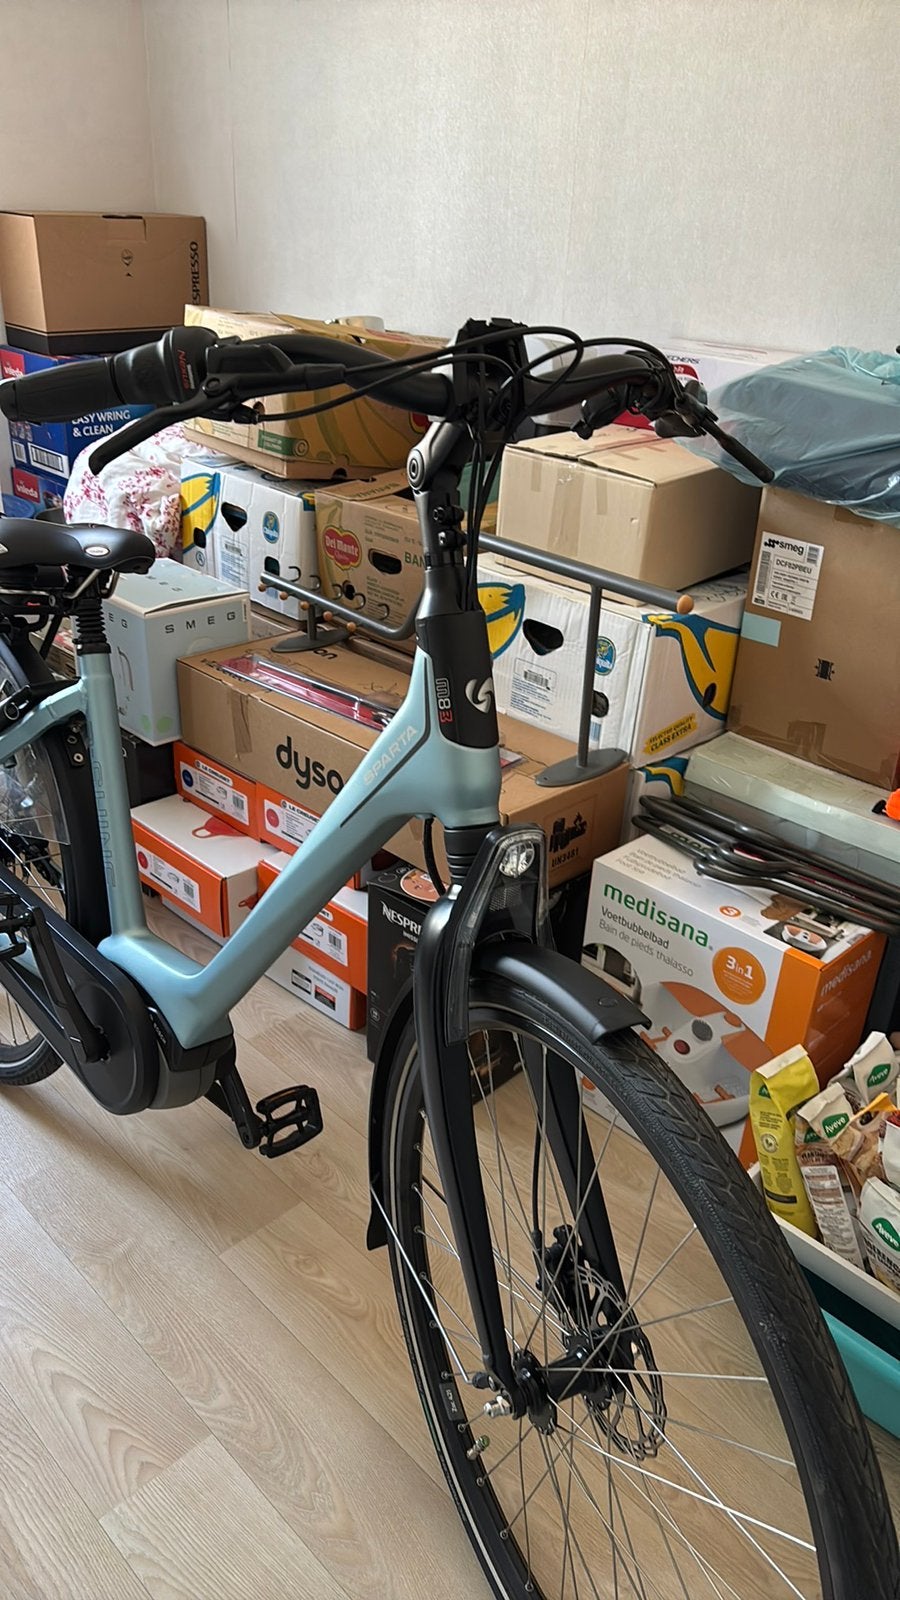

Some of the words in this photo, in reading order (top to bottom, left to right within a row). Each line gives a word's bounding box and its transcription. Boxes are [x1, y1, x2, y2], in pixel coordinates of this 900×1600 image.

[190, 241, 201, 306] ESPRESSO
[73, 426, 82, 438] &
[83, 424, 114, 435] CLEAN
[97, 409, 131, 420] WRING
[325, 536, 336, 548] Del
[336, 539, 358, 557] Monte
[404, 551, 425, 568] BAN
[778, 540, 804, 556] smeg
[164, 611, 237, 635] SMEG
[276, 735, 345, 796] dyso
[364, 725, 417, 785] SPARTA
[601, 905, 670, 950] Voetbubbelbad
[603, 883, 709, 948] medisana
[599, 918, 618, 936] Bain
[618, 931, 630, 943] de
[630, 938, 654, 957] pieds
[656, 950, 694, 977] thalasso
[820, 949, 872, 997] medisana
[824, 1117, 847, 1134] Aveve
